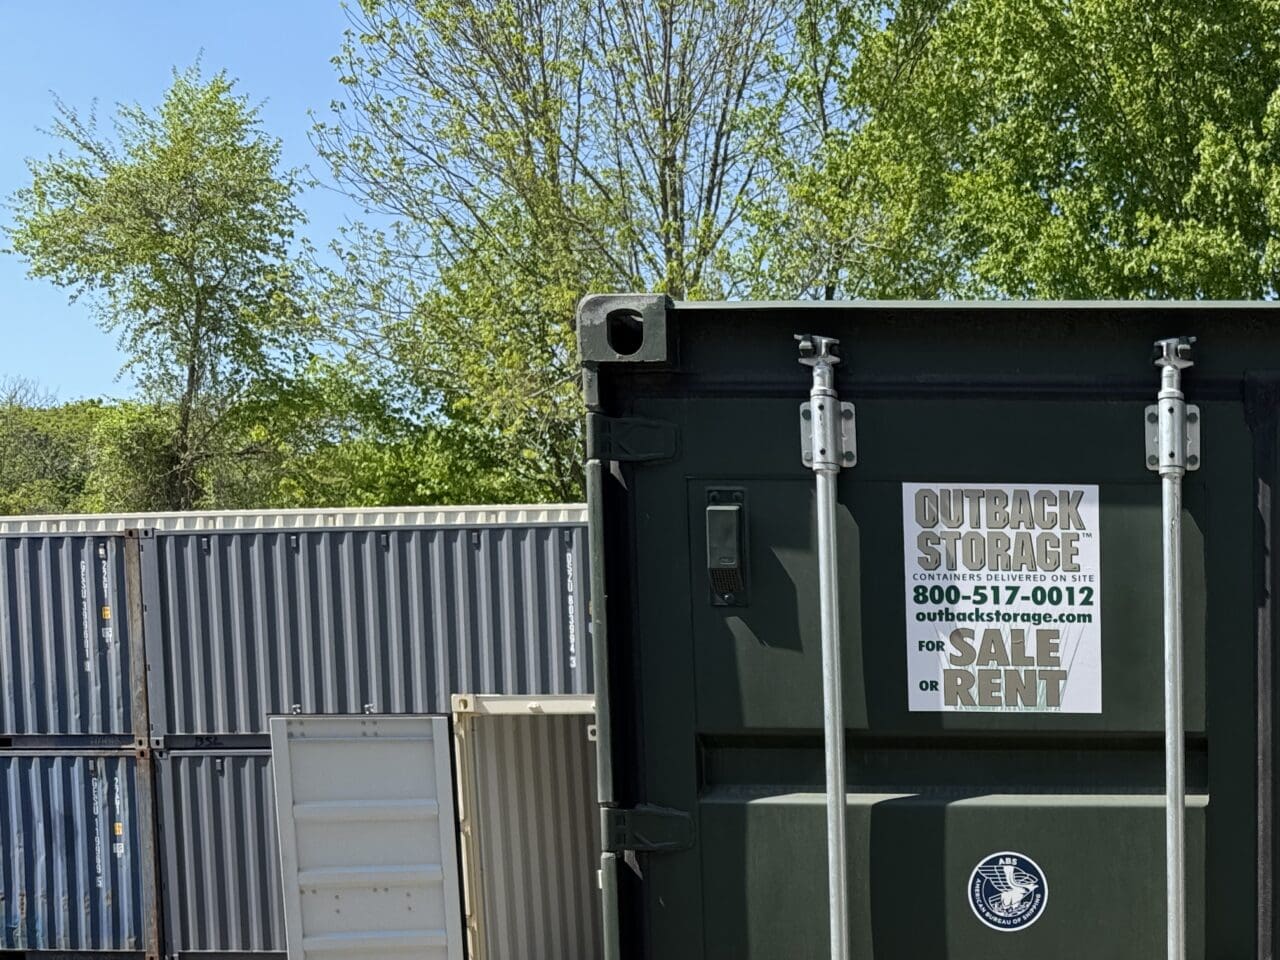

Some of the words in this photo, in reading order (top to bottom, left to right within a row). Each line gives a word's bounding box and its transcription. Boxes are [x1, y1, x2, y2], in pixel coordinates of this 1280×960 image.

[914, 488, 1086, 530] OUTBACK
[917, 531, 1080, 572] STORAGE
[913, 573, 982, 581] CONTAINERS
[986, 574, 1047, 582] DELIVERED
[1051, 574, 1067, 582] ON
[1071, 574, 1094, 582] SITE
[913, 585, 1094, 606] 800-517-0012
[916, 608, 1092, 625] outbackstorage.com
[918, 640, 945, 652] FOR
[949, 627, 1061, 667] SALE
[919, 680, 939, 691] OR
[943, 668, 1067, 707] RENT
